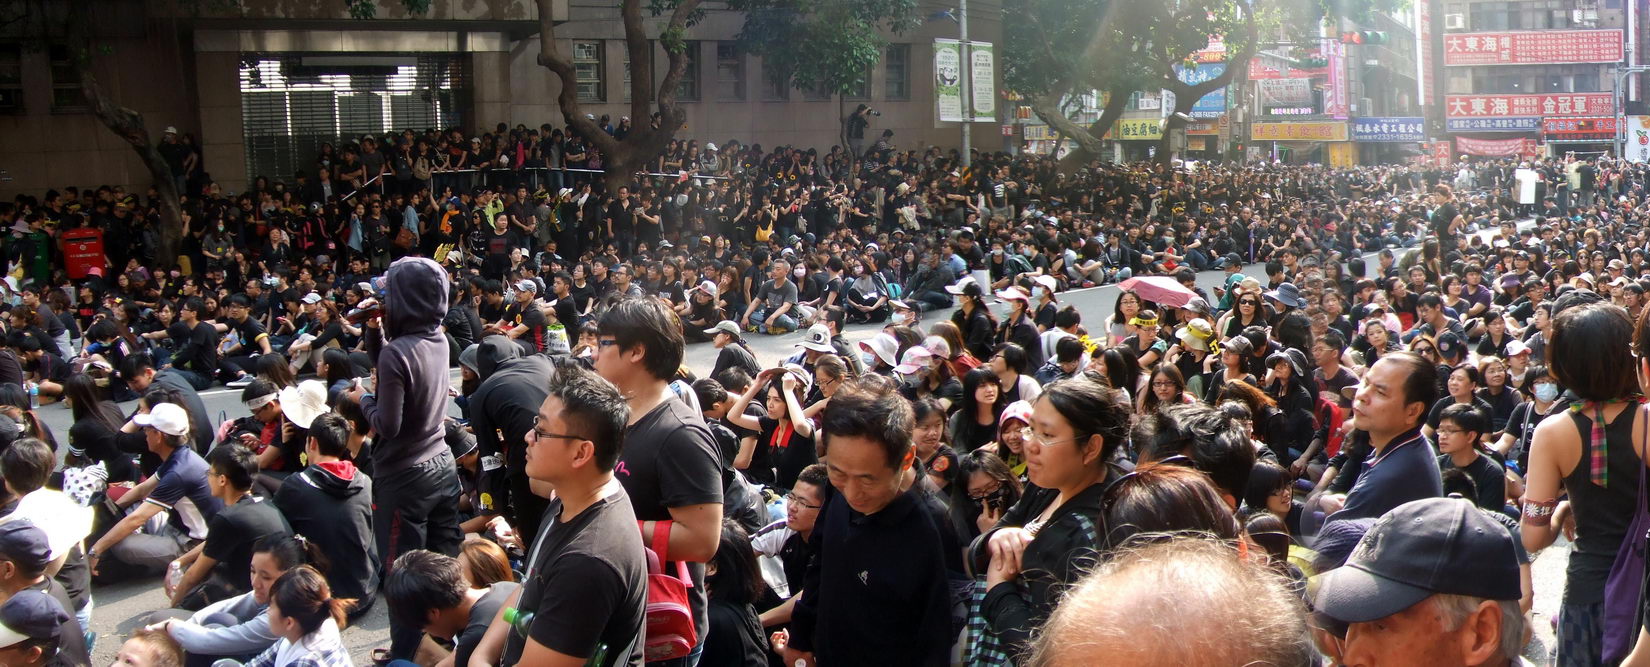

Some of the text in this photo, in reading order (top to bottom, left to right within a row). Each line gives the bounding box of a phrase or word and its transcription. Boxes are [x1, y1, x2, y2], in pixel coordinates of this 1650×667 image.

[1448, 37, 1497, 52] 大東海
[1450, 98, 1509, 115] 大東海
[1542, 96, 1587, 115] 金冠軍
